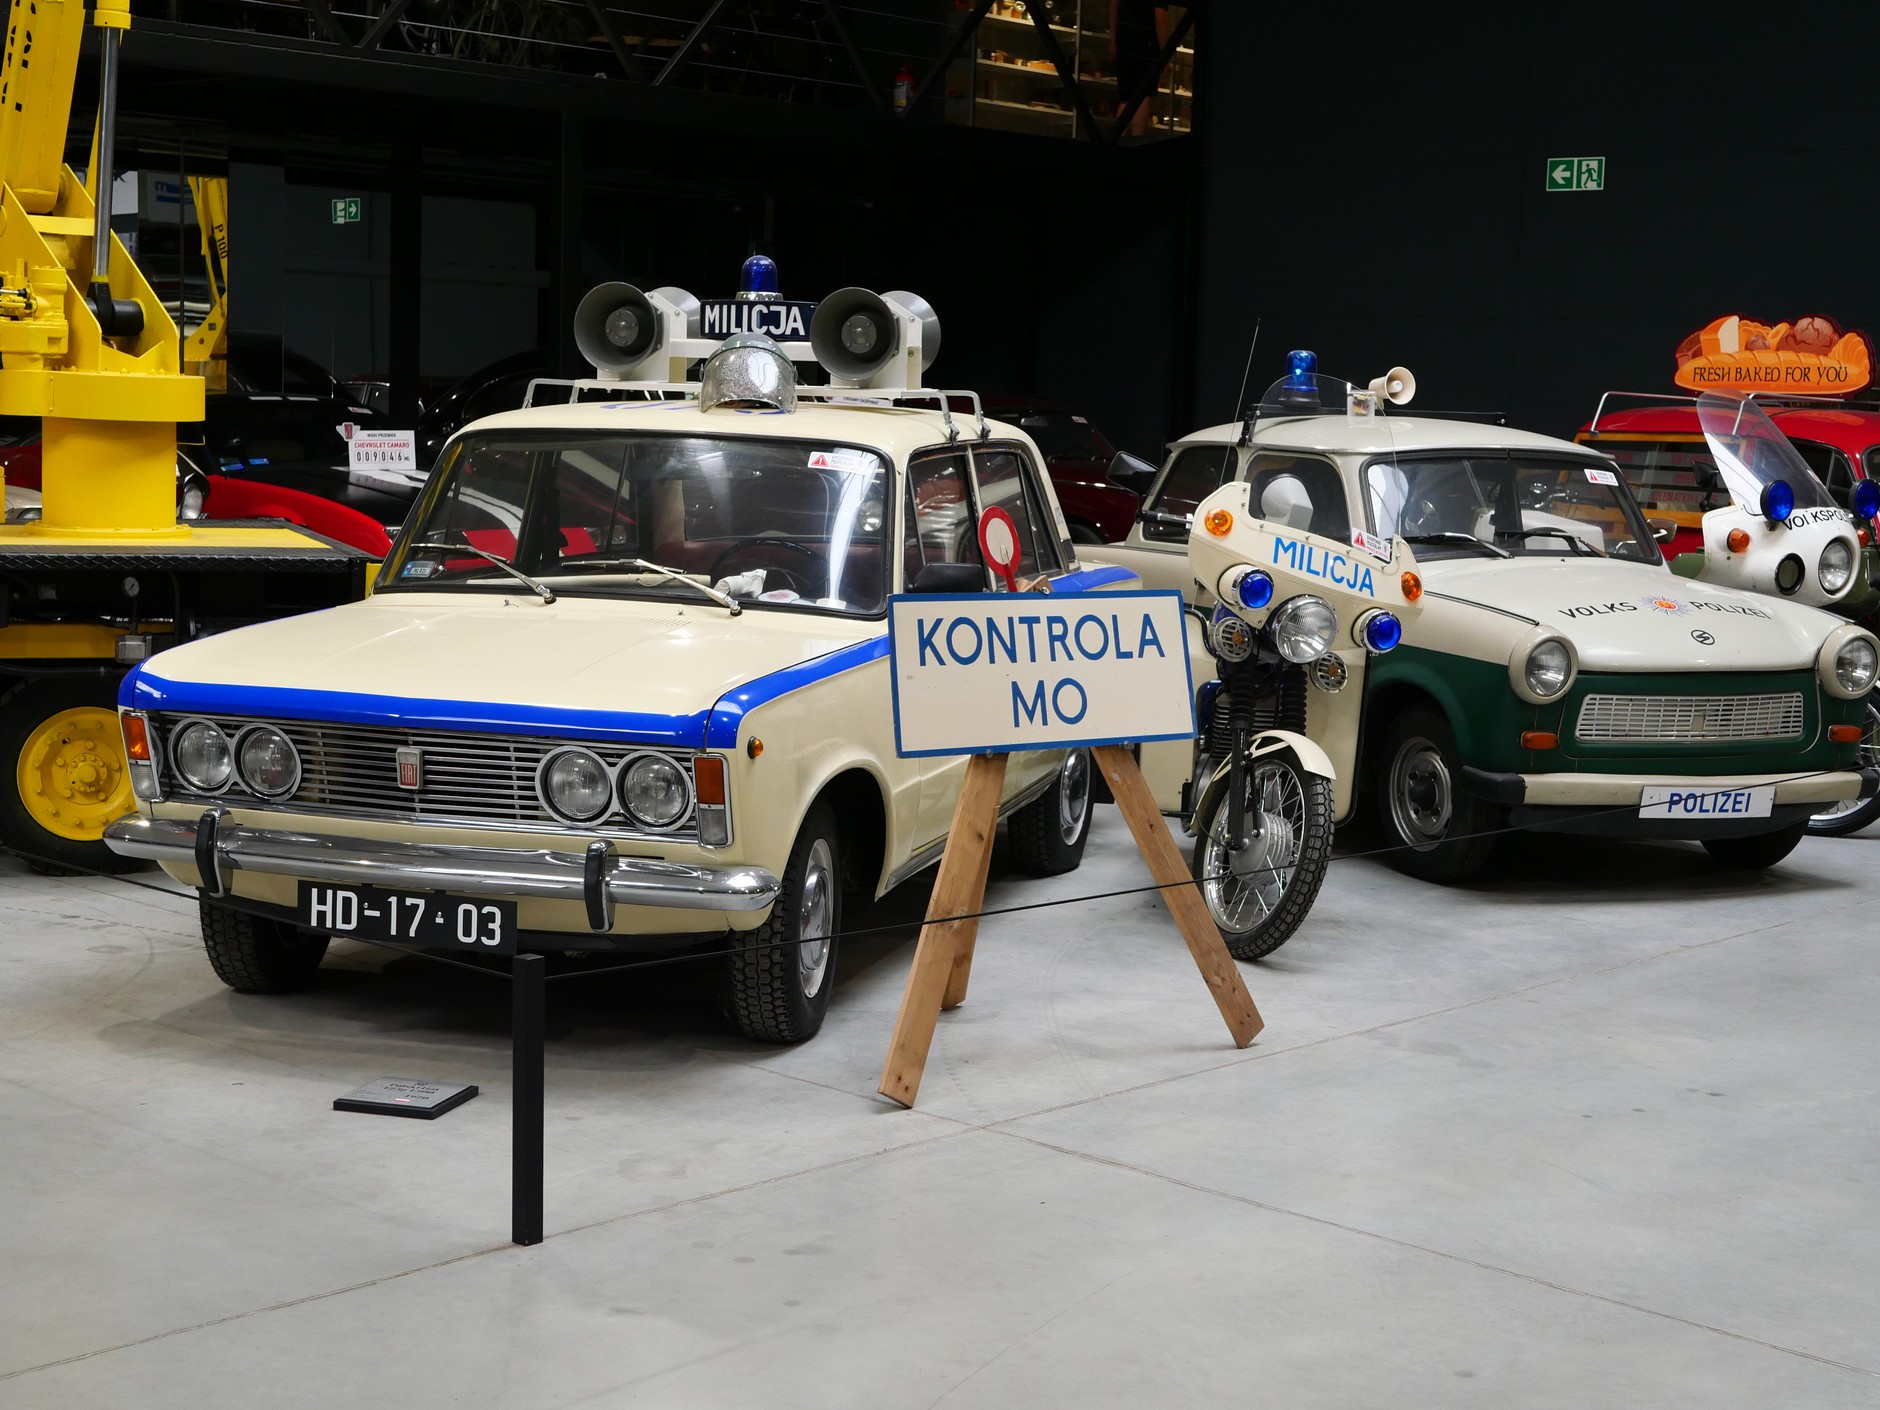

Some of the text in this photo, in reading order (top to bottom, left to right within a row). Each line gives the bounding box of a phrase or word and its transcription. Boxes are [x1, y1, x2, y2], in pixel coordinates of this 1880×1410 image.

[704, 304, 806, 336] MILICJA
[1693, 366, 1848, 386] FRESH BAKED FOR YOU
[356, 451, 402, 462] 009046
[1273, 537, 1375, 597] MILICJA
[1558, 601, 1772, 620] VOLKS POLIZEI
[917, 613, 1166, 667] KONTROLA
[1011, 677, 1088, 728] MO
[401, 763, 417, 785] FIAT
[1667, 792, 1752, 813] POLIZEI
